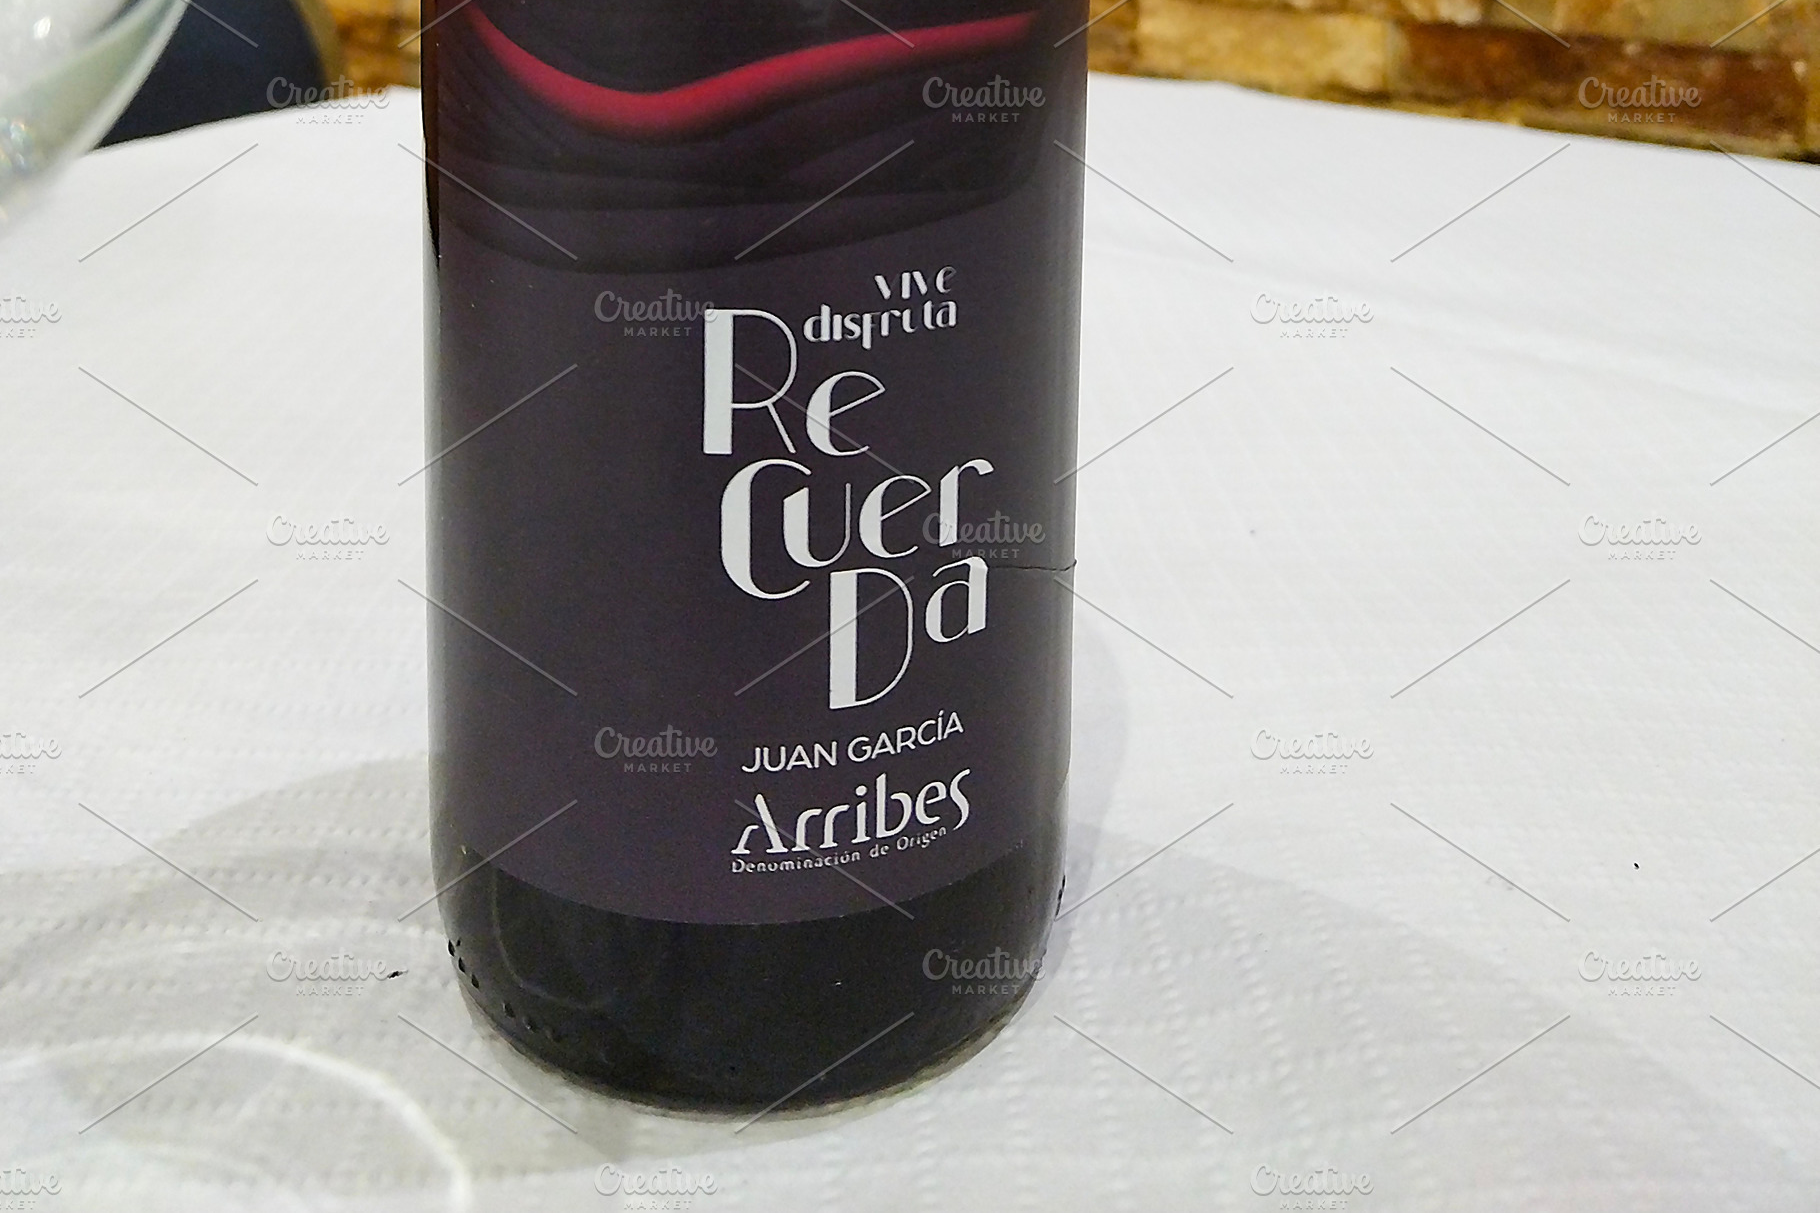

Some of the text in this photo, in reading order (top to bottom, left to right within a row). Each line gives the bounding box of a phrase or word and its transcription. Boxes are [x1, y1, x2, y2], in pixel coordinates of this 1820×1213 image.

[703, 308, 886, 457] Re
[720, 458, 994, 600] Cuer
[829, 556, 988, 710] Da
[741, 710, 964, 773] JUAN GARCÍA
[731, 768, 971, 855] Arribes
[731, 826, 946, 873] Denominación de Origen
